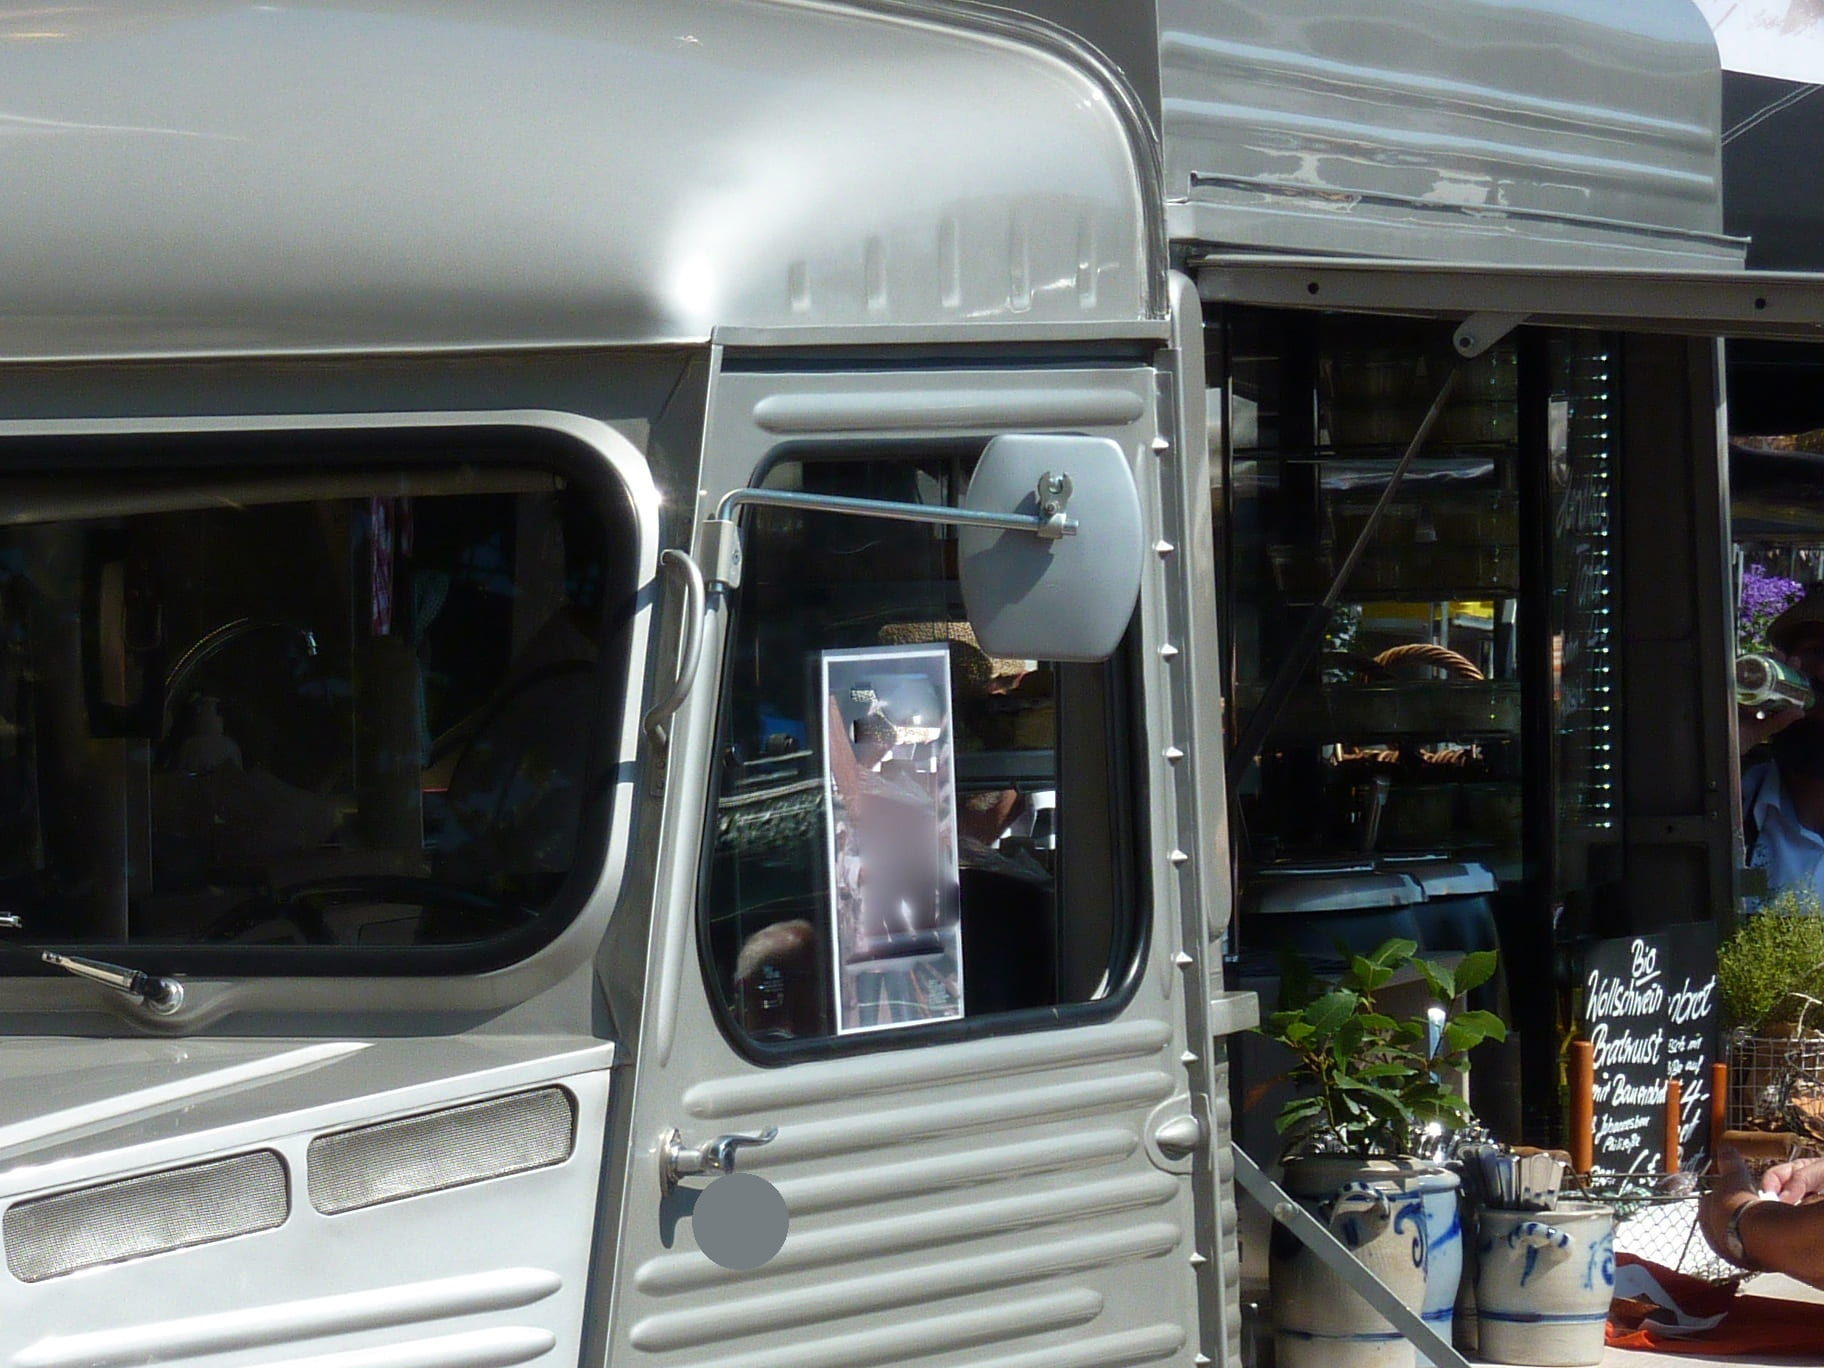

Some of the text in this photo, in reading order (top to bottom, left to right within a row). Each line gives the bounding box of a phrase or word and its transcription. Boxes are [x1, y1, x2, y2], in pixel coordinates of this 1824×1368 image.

[1631, 939, 1658, 979] Bio
[1586, 969, 1663, 1022] Wollschwein
[1591, 1023, 1663, 1070] Bratwurst
[1592, 1072, 1611, 1102] mit
